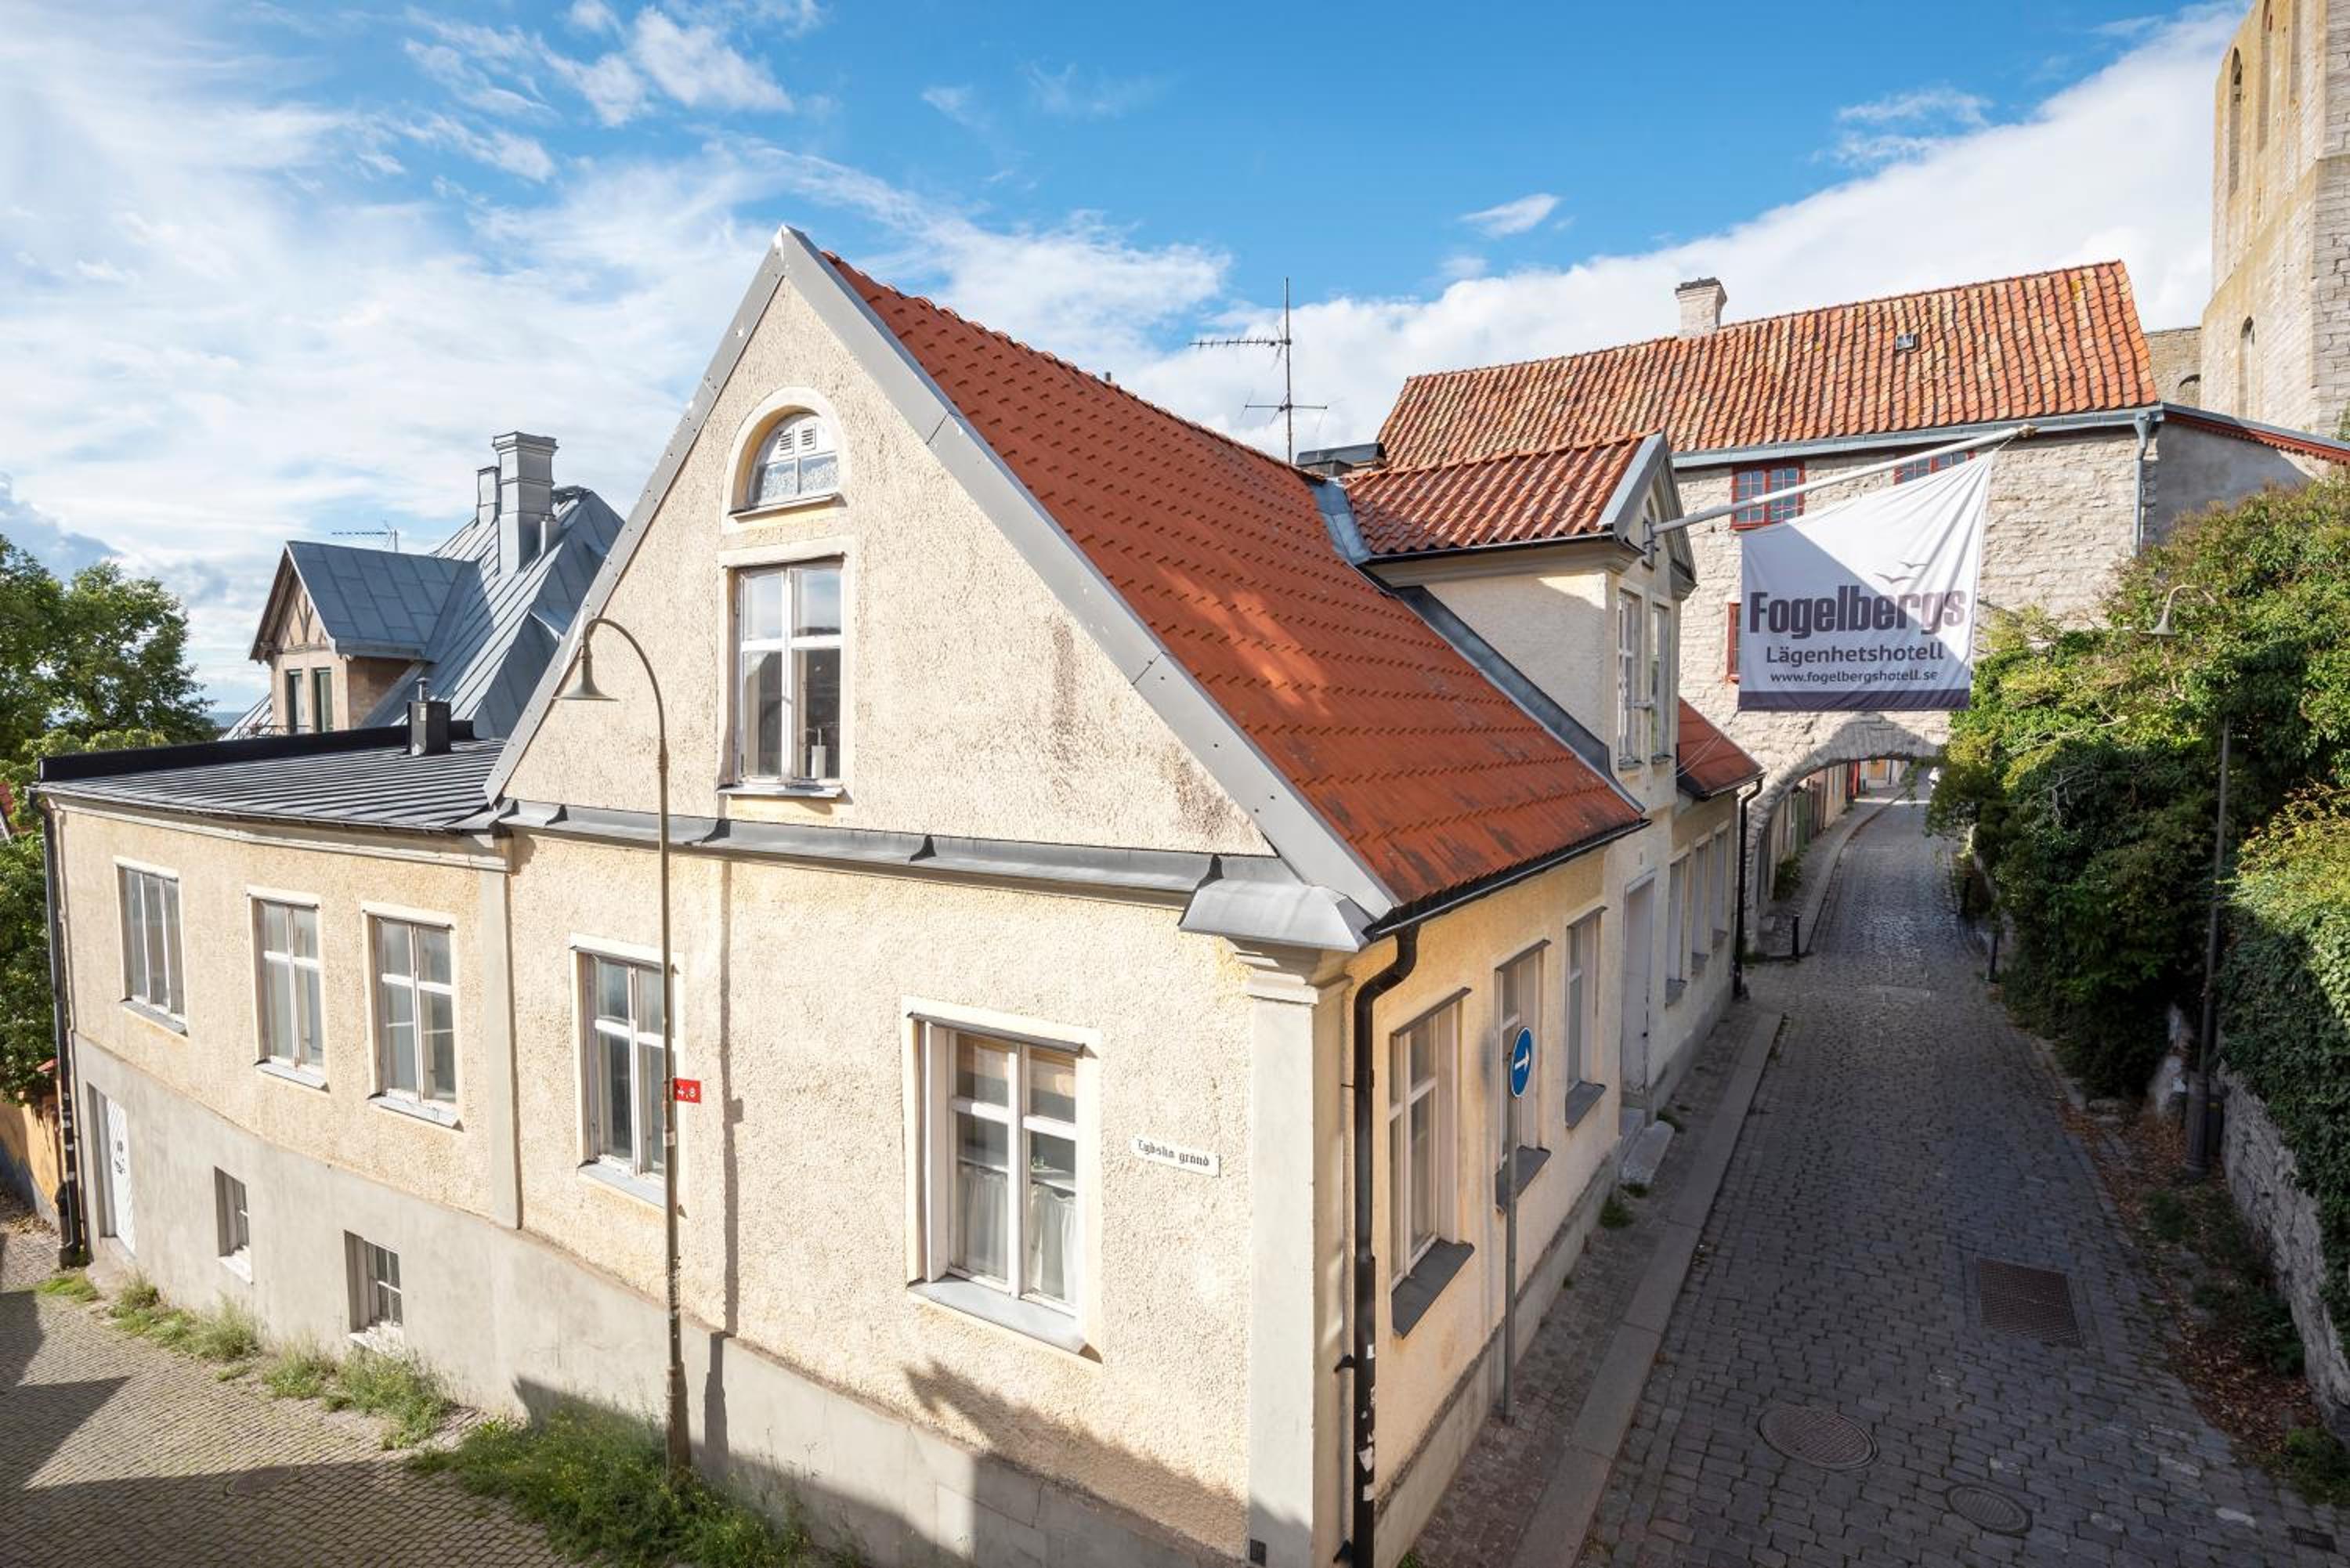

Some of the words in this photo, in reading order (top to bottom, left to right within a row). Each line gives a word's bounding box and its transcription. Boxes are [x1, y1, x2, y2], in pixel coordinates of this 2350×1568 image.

[1749, 585, 1966, 639] Fogelbergs
[1766, 642, 1943, 667] Lägenhetshotell
[1770, 670, 1938, 685] www.fogelbergshotell.se
